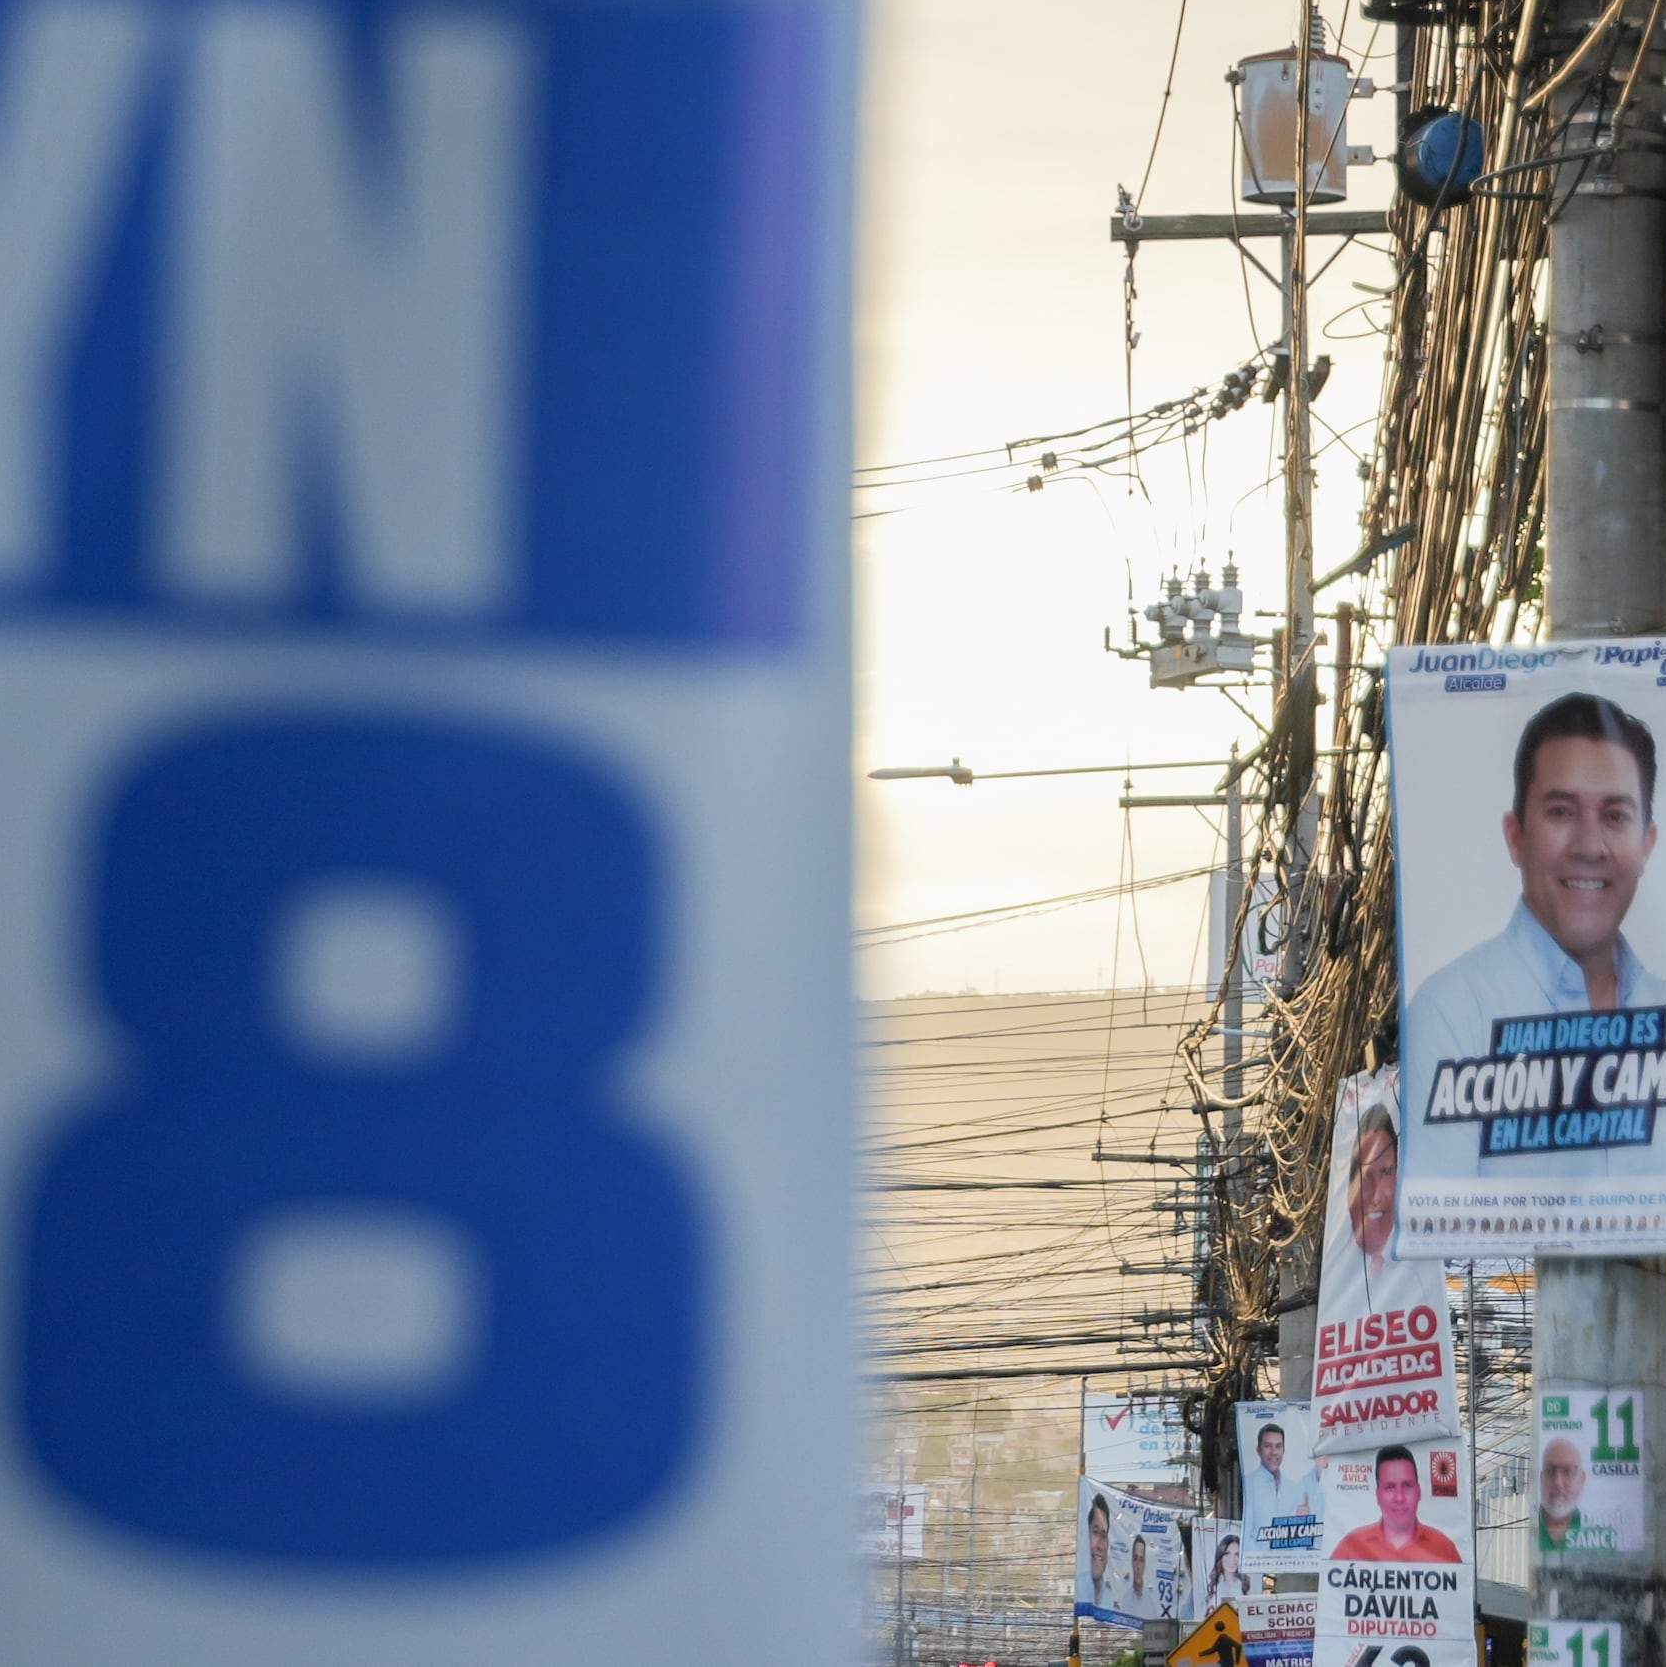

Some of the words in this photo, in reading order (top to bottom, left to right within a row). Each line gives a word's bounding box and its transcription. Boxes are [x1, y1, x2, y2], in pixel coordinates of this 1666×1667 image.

[1447, 676, 1502, 691] Alcalde
[1496, 1019, 1553, 1055] JUAN
[1555, 1014, 1627, 1050] DIEGO
[1631, 1012, 1659, 1045] ES
[1430, 1053, 1554, 1117] ACCIÓN
[1560, 1056, 1588, 1106] Y
[1489, 1117, 1523, 1151] EN
[1520, 1114, 1550, 1147] LA
[1554, 1108, 1647, 1145] CAPITAL
[1407, 1196, 1440, 1207] VOTA
[1444, 1196, 1461, 1207] EN
[1503, 1196, 1526, 1207] POR
[1531, 1195, 1566, 1207] TODO
[1319, 1305, 1438, 1360] ELISEO
[1319, 1355, 1399, 1390] ALCALDE
[1320, 1389, 1439, 1428] SALVADOR
[1318, 1412, 1442, 1439] PRESIDENTE
[1590, 1394, 1640, 1463] 11
[1591, 1464, 1639, 1476] CASILLA
[1327, 1563, 1457, 1591] CÁRLENTON
[1158, 1580, 1173, 1603] 93
[1344, 1585, 1439, 1620] DÁVILA
[1247, 1605, 1264, 1616] EL
[1268, 1600, 1318, 1615] CENÁC
[1268, 1616, 1315, 1628] SCHOO
[1347, 1619, 1438, 1638] DIPUTADO
[1265, 1657, 1314, 1667] MATRIC
